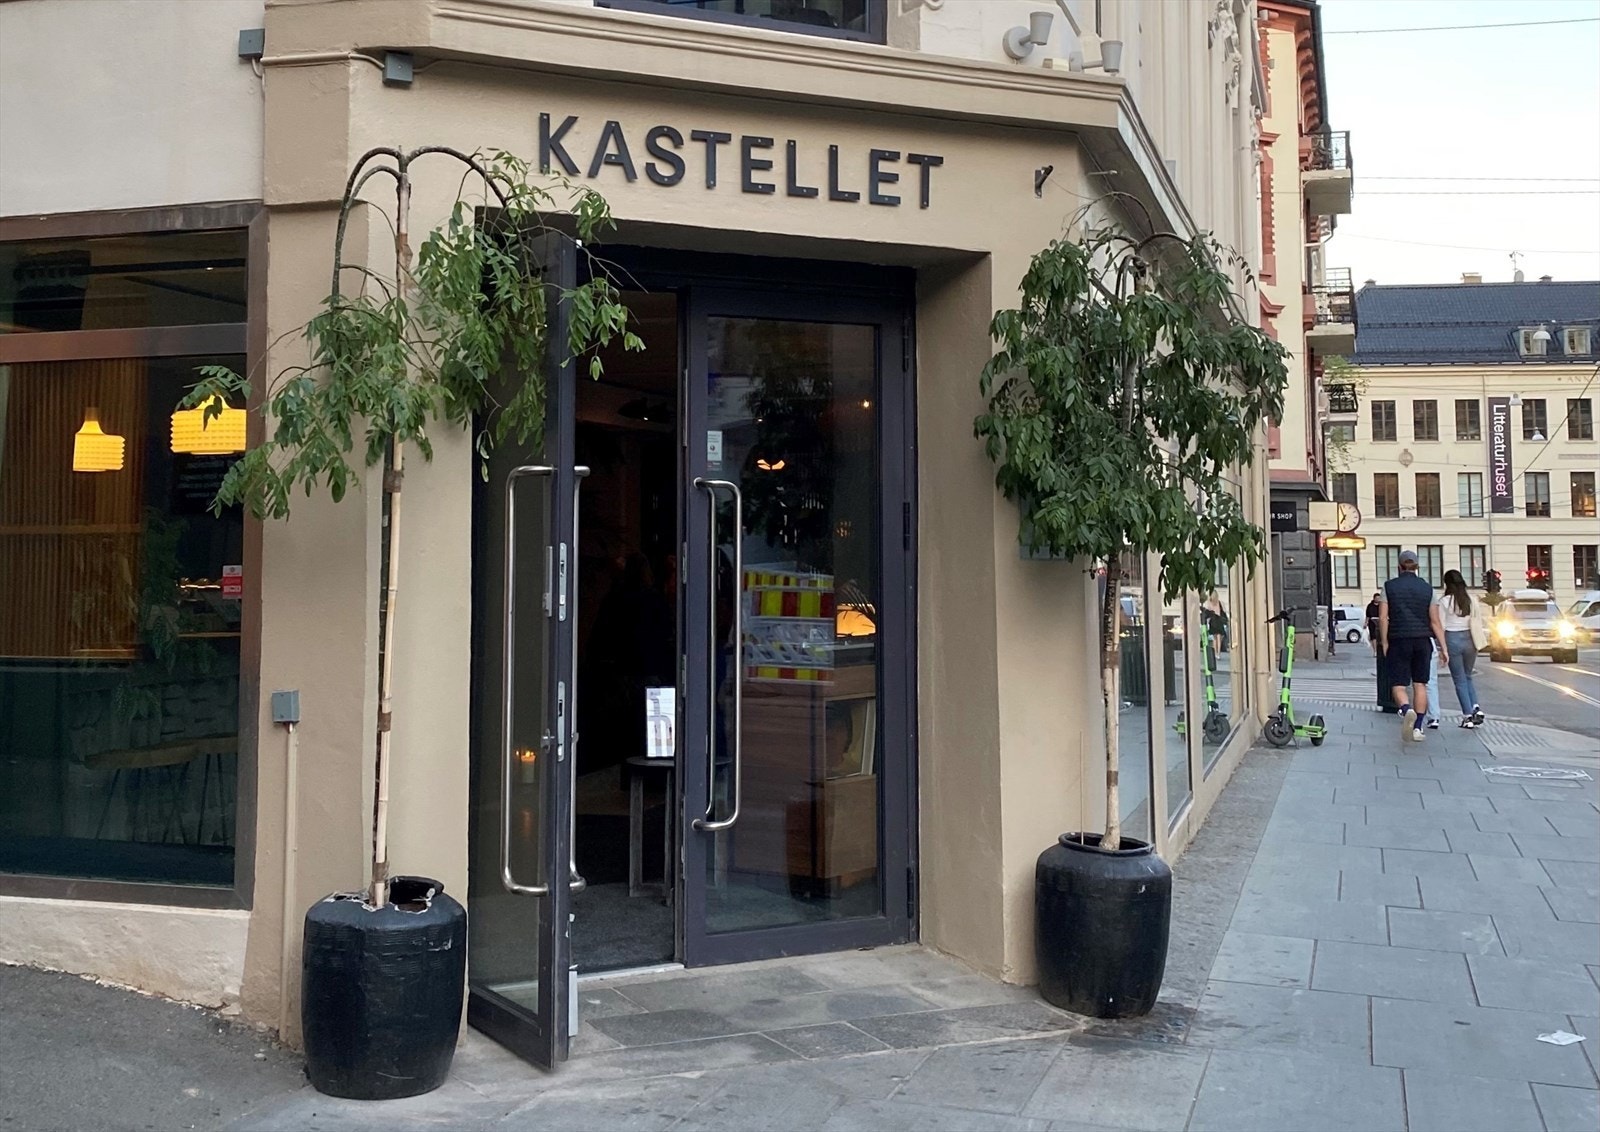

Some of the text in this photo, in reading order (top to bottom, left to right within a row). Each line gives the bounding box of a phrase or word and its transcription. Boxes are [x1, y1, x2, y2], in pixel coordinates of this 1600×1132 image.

[539, 112, 943, 208] KASTELLET
[1493, 404, 1508, 496] Litteraturhuset
[1277, 512, 1293, 520] SHOP
